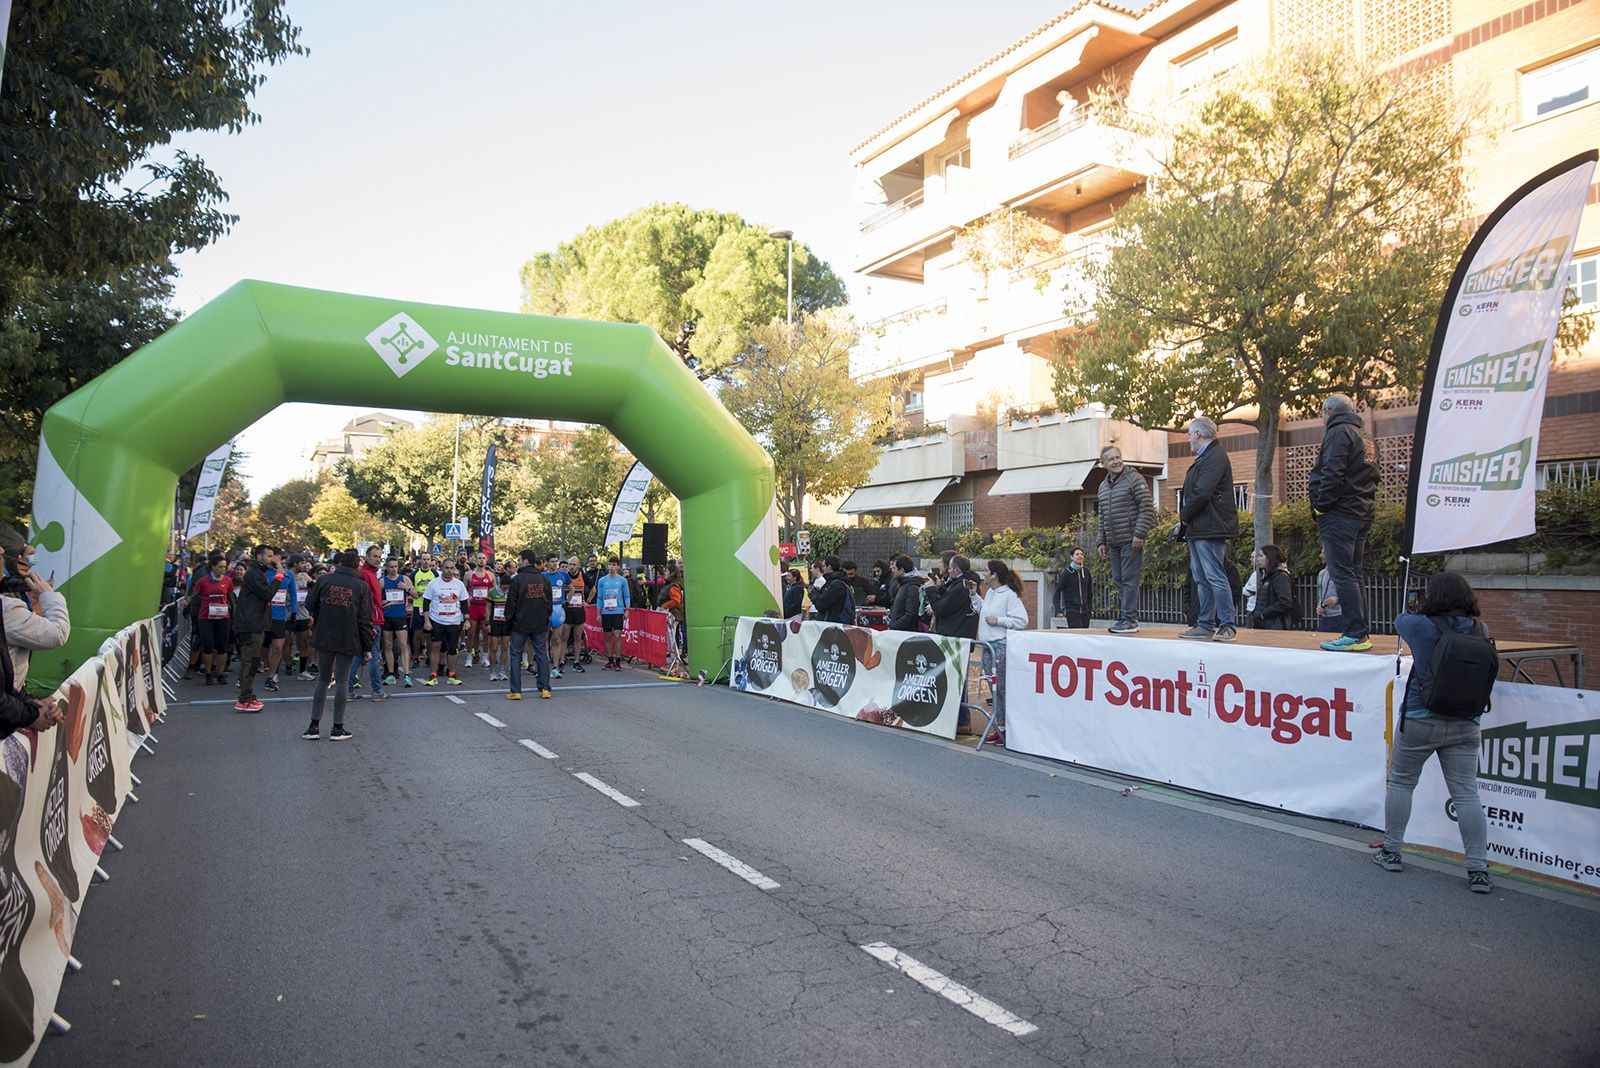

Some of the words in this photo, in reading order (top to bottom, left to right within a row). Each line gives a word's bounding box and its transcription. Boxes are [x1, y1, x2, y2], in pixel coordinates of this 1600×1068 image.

[1466, 248, 1557, 292] FINISHER
[1475, 301, 1499, 310] KERN
[447, 331, 549, 353] AJUNTAMENT
[554, 342, 573, 355] DE
[445, 346, 573, 379] SantCugat
[1446, 350, 1541, 387] FINISHER
[1431, 450, 1522, 482] FINISHER
[1444, 496, 1471, 504] KERN
[750, 658, 779, 674] ORIGEN
[816, 660, 850, 674] AMETLLER
[816, 670, 848, 689] ORIGEN
[903, 673, 937, 688] AMETLLER
[897, 685, 938, 705] ORIGEN
[1214, 673, 1353, 744] Cugat
[1476, 734, 1600, 790] NISHE
[1477, 781, 1502, 793] TRICIÓN
[1503, 786, 1537, 799] DEPORTIVA
